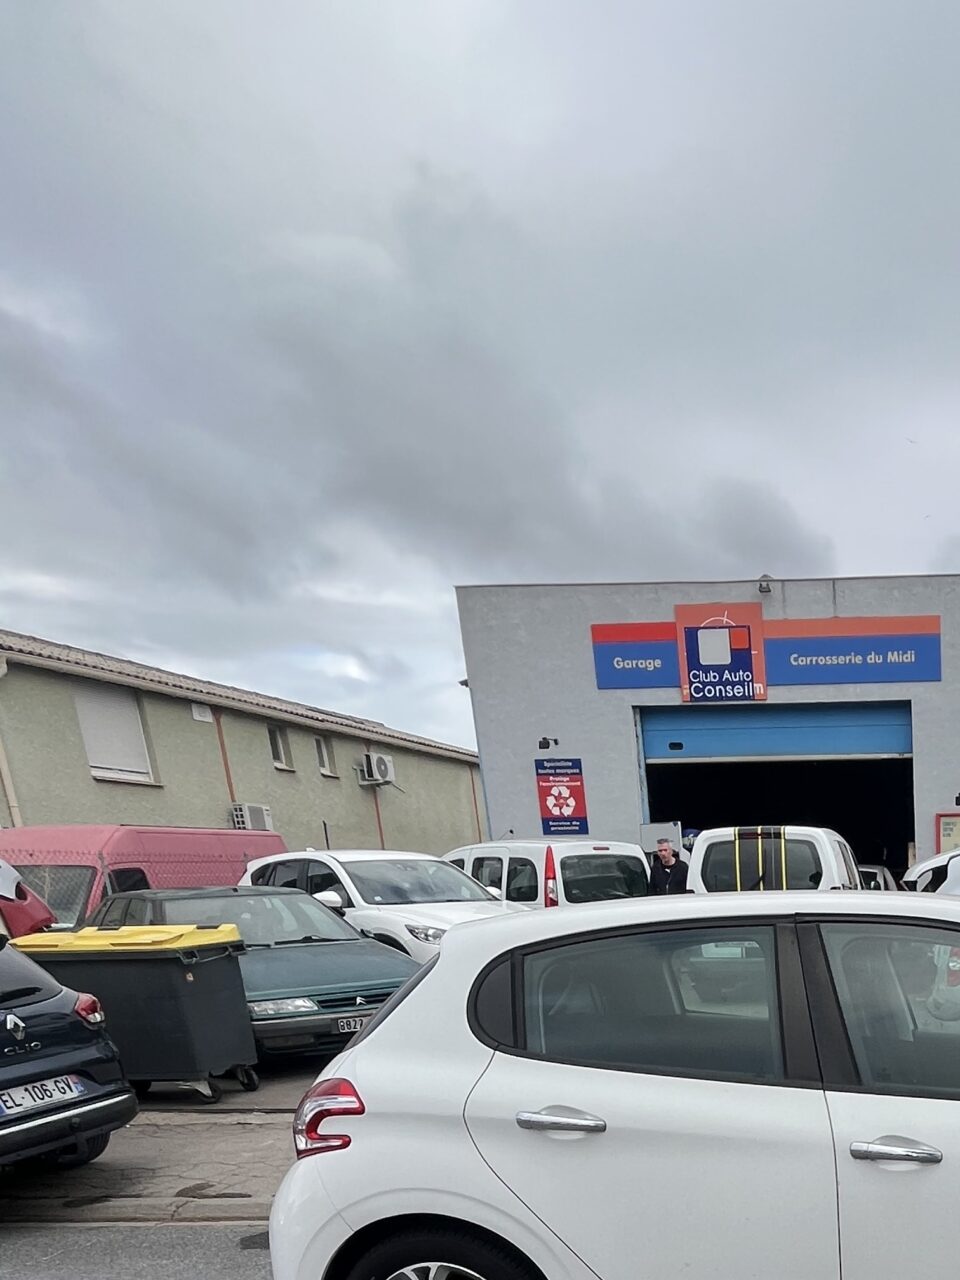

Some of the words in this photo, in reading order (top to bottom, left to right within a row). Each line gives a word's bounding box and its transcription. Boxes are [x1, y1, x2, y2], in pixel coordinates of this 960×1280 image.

[613, 656, 662, 671] Garage
[790, 651, 862, 666] Carrosserie
[866, 650, 884, 663] du
[887, 649, 916, 663] Midi
[689, 669, 719, 682] Club
[722, 668, 752, 682] Auto
[690, 681, 753, 697] Conseil
[4, 1041, 41, 1056] CLIO
